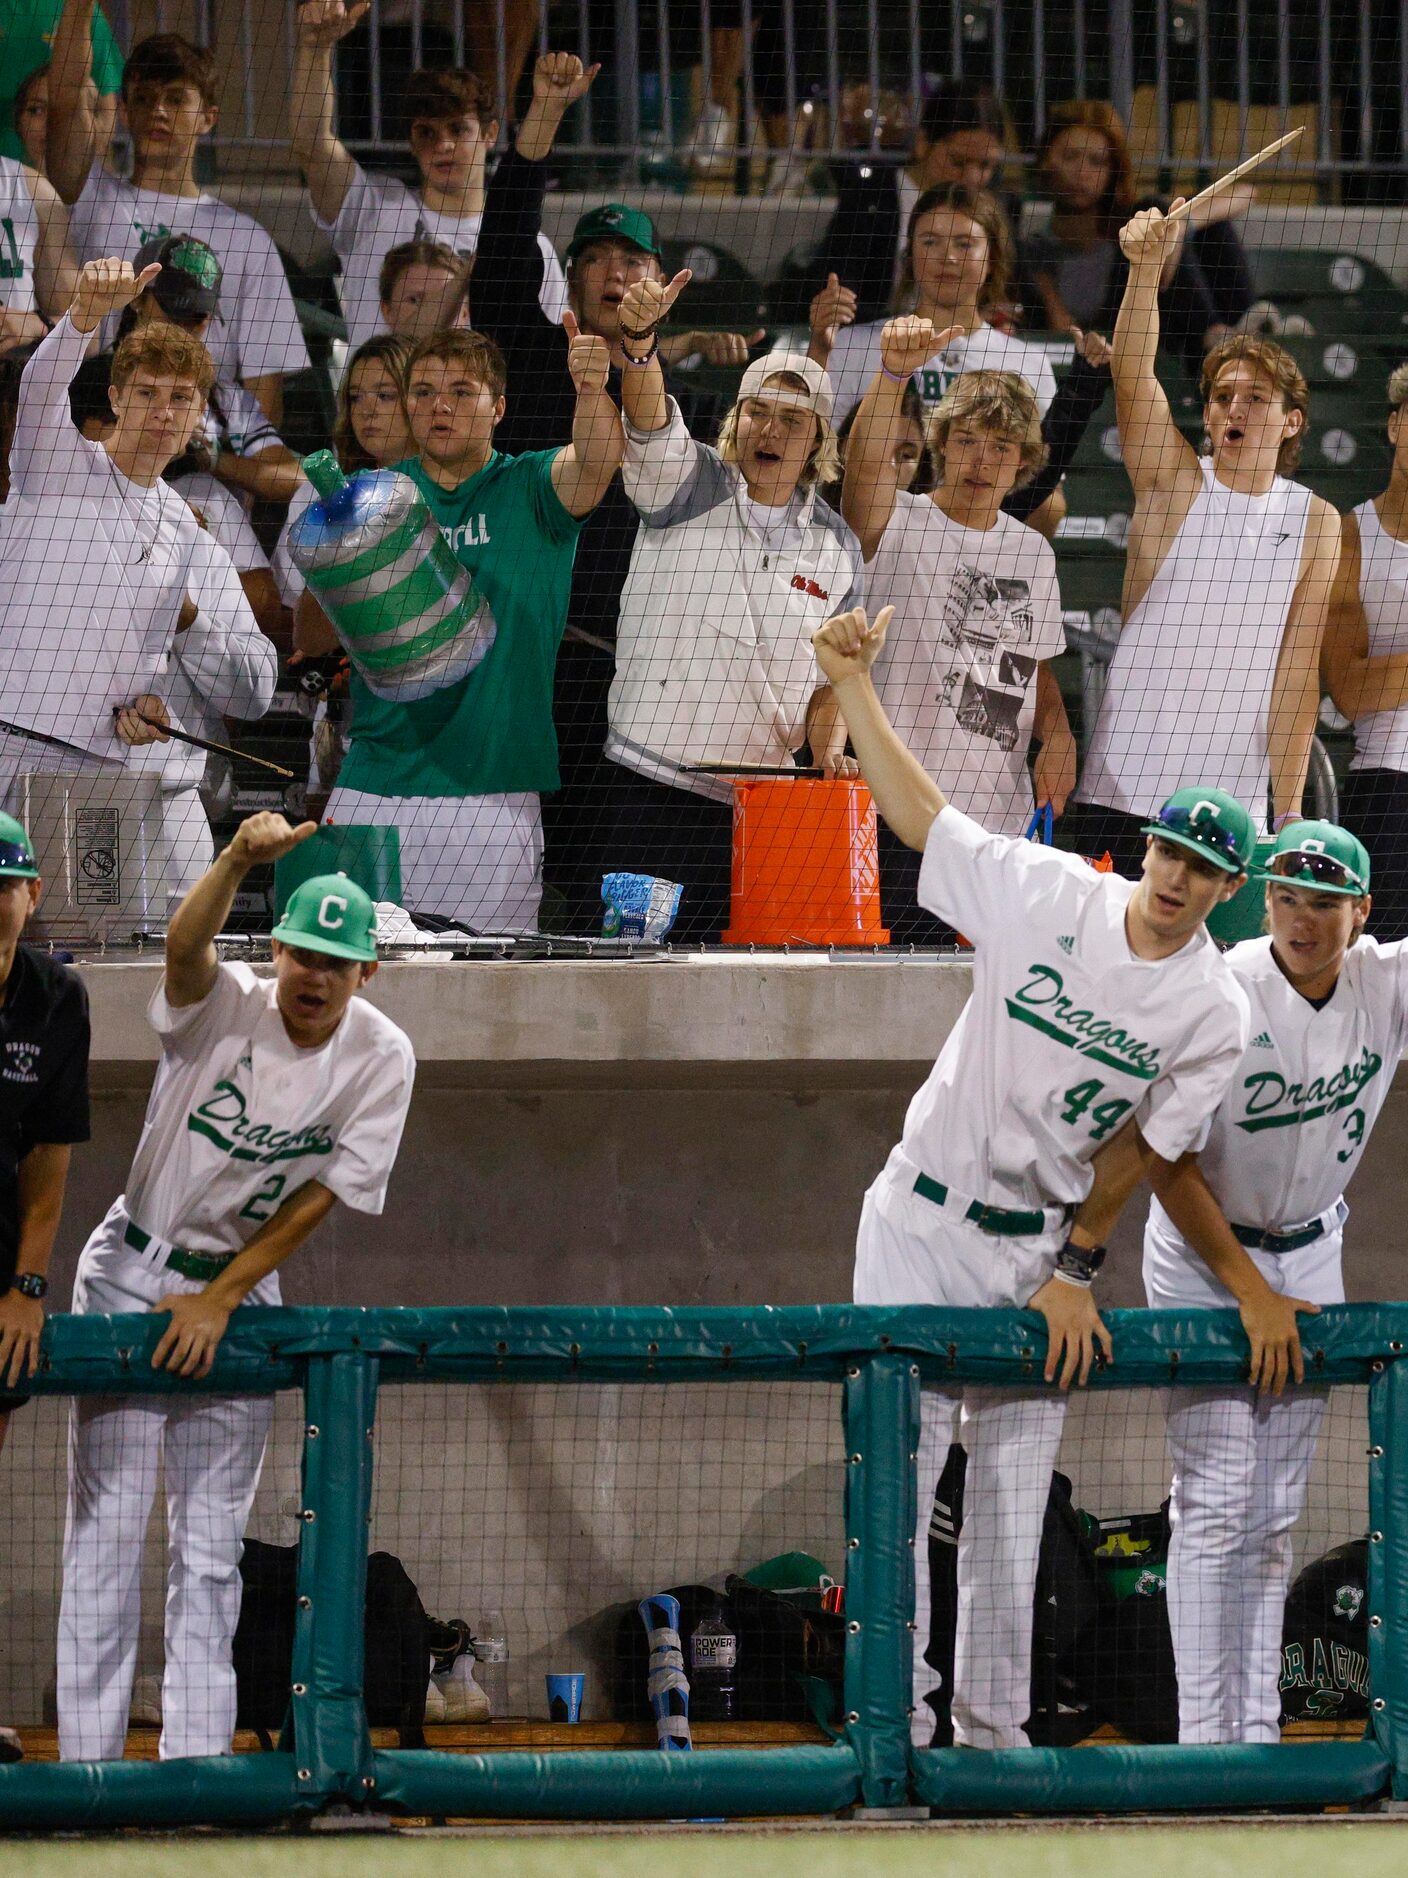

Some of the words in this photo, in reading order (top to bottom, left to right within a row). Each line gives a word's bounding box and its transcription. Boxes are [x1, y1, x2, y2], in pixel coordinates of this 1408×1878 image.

[318, 894, 348, 930] C
[1011, 964, 1160, 1079] Dragons
[193, 1079, 333, 1164] Dragons
[1060, 1078, 1133, 1140] 44
[1337, 1107, 1366, 1163] 3
[239, 1174, 287, 1221] 2
[695, 1638, 733, 1648] POWER
